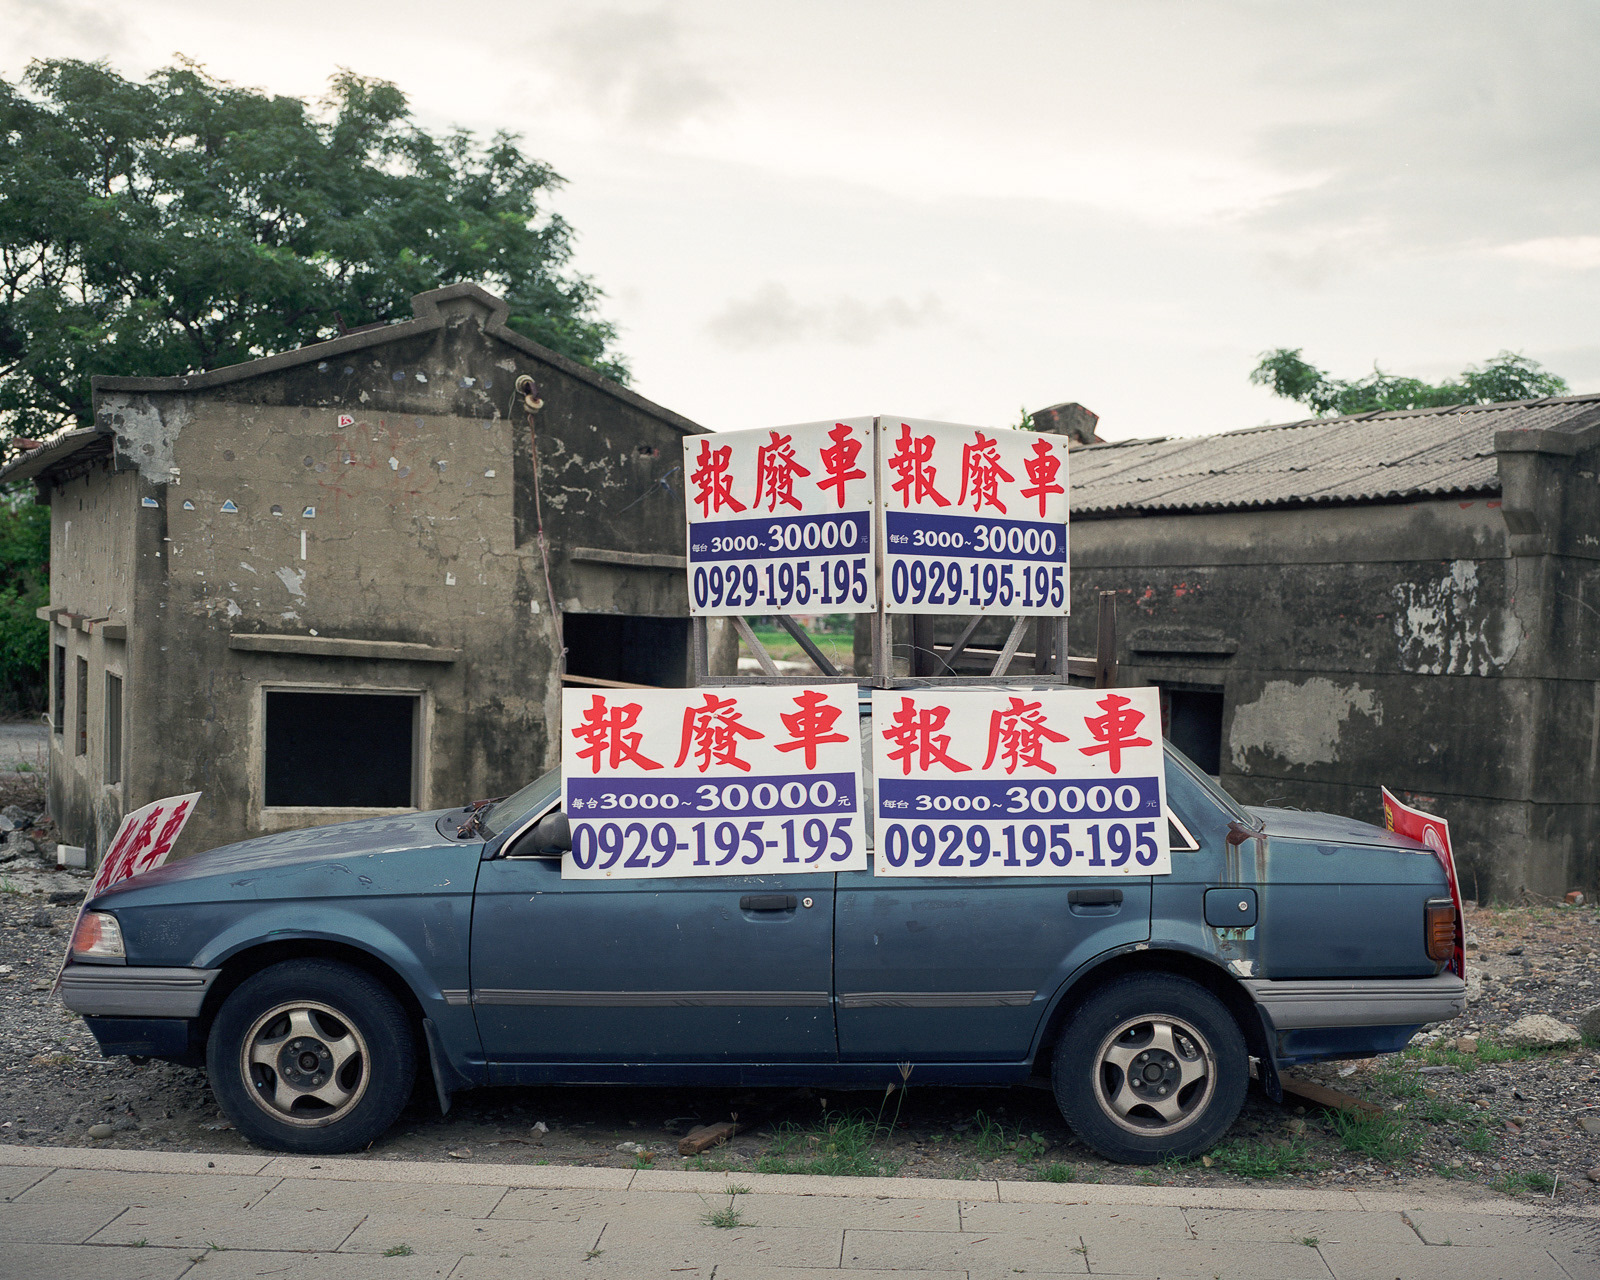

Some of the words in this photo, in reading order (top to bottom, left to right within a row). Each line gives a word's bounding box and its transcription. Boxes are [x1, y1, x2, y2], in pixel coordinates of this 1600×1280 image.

[690, 423, 867, 518] 報廢車
[888, 423, 1065, 518] 報廢車
[694, 558, 868, 608] 0929-195-195
[892, 559, 1065, 608] 0929-195-195
[571, 690, 850, 774] 報廢車
[882, 693, 1153, 776] 報廢車
[571, 817, 853, 870] 0929-195-195
[884, 821, 1159, 868] 0929-195-195
